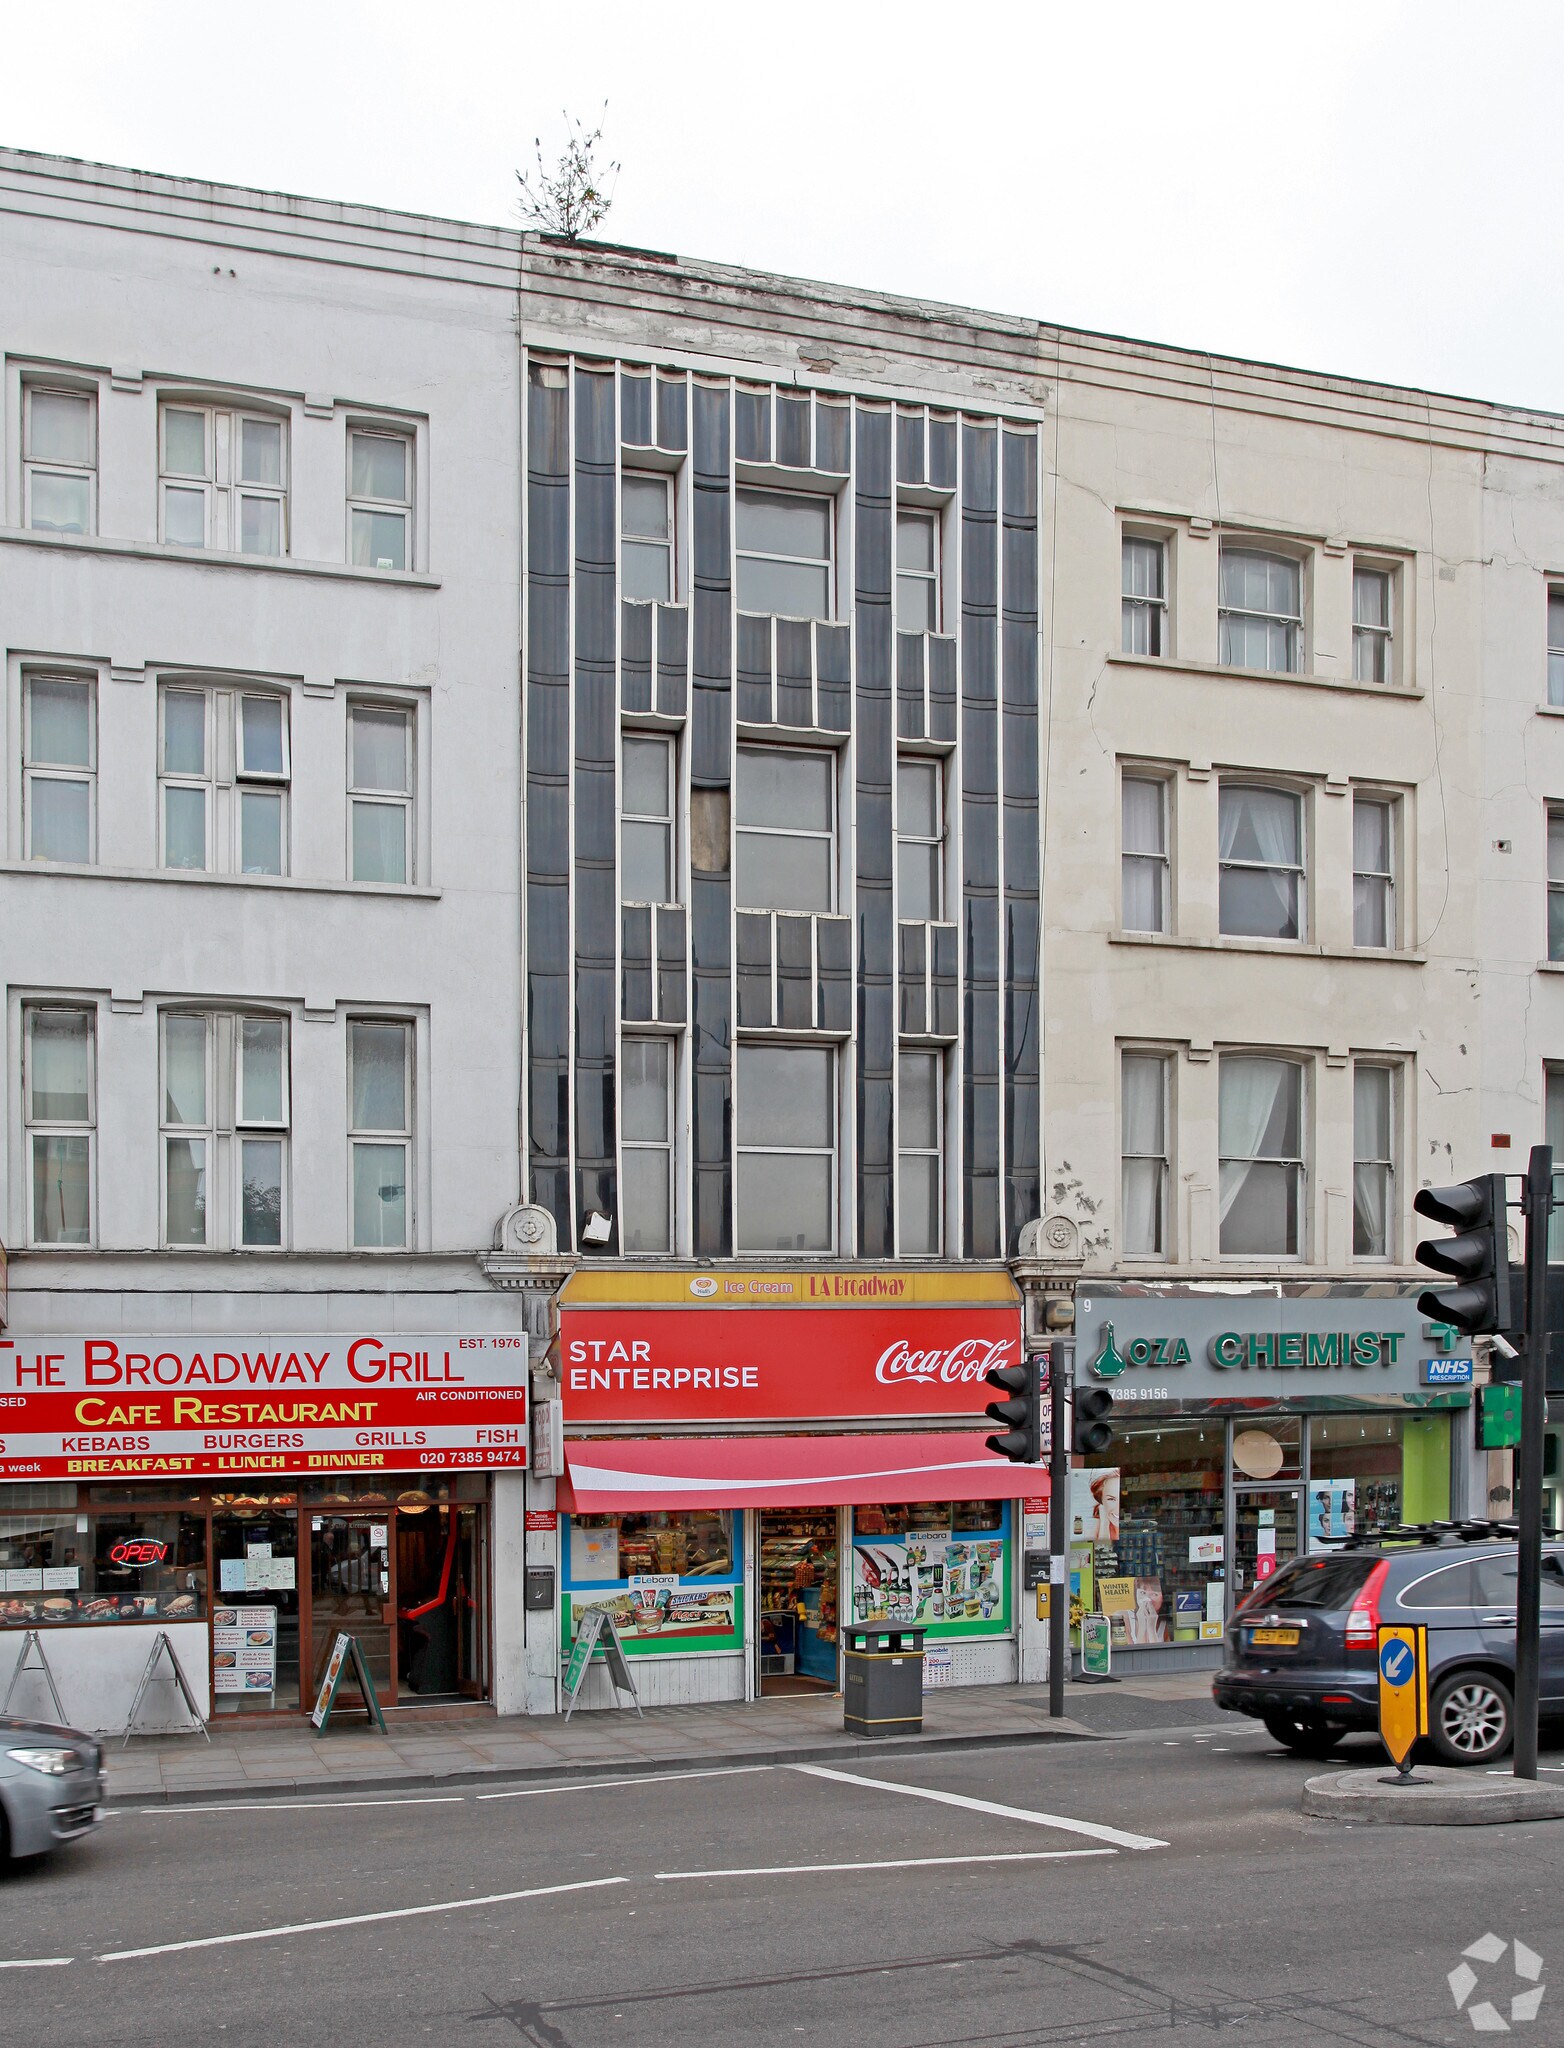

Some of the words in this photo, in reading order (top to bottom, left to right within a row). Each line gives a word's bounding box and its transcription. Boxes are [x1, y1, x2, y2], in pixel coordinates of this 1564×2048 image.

[724, 1280, 745, 1293] Ice
[749, 1280, 793, 1293] Cream
[810, 1277, 829, 1296] LA
[834, 1276, 907, 1296] Broadway
[1083, 1299, 1092, 1313] 9
[459, 1339, 487, 1349] EST.
[491, 1338, 521, 1349] 1976
[569, 1340, 651, 1362] STAR
[1126, 1338, 1192, 1366] OZA
[1211, 1331, 1405, 1368] CHEMIST
[84, 1340, 330, 1386] BROADWAY
[347, 1338, 465, 1383] GRILL
[1429, 1360, 1470, 1374] NHS
[570, 1366, 759, 1390] ENTERPRISE
[416, 1391, 437, 1401] AIR
[440, 1390, 522, 1401] CONDITIONED
[1140, 1388, 1168, 1399] 9156
[75, 1398, 161, 1426] CAFE
[174, 1397, 378, 1424] RESTAURANT
[62, 1436, 150, 1452] KEBABS
[203, 1433, 304, 1449] BURGERS
[355, 1431, 427, 1446] GRILLS
[476, 1429, 519, 1443] FISH
[67, 1457, 195, 1473] BREAKFAST
[218, 1455, 285, 1469] LUNCH
[308, 1453, 384, 1467] DINNER
[420, 1452, 446, 1464] 020
[450, 1452, 483, 1464] 7385
[487, 1451, 520, 1463] 9474
[8, 1462, 41, 1473] week
[110, 1545, 168, 1561] OPEN
[641, 1576, 674, 1584] Lebara
[671, 1592, 708, 1605] SNICKERS
[1177, 1594, 1189, 1610] 7
